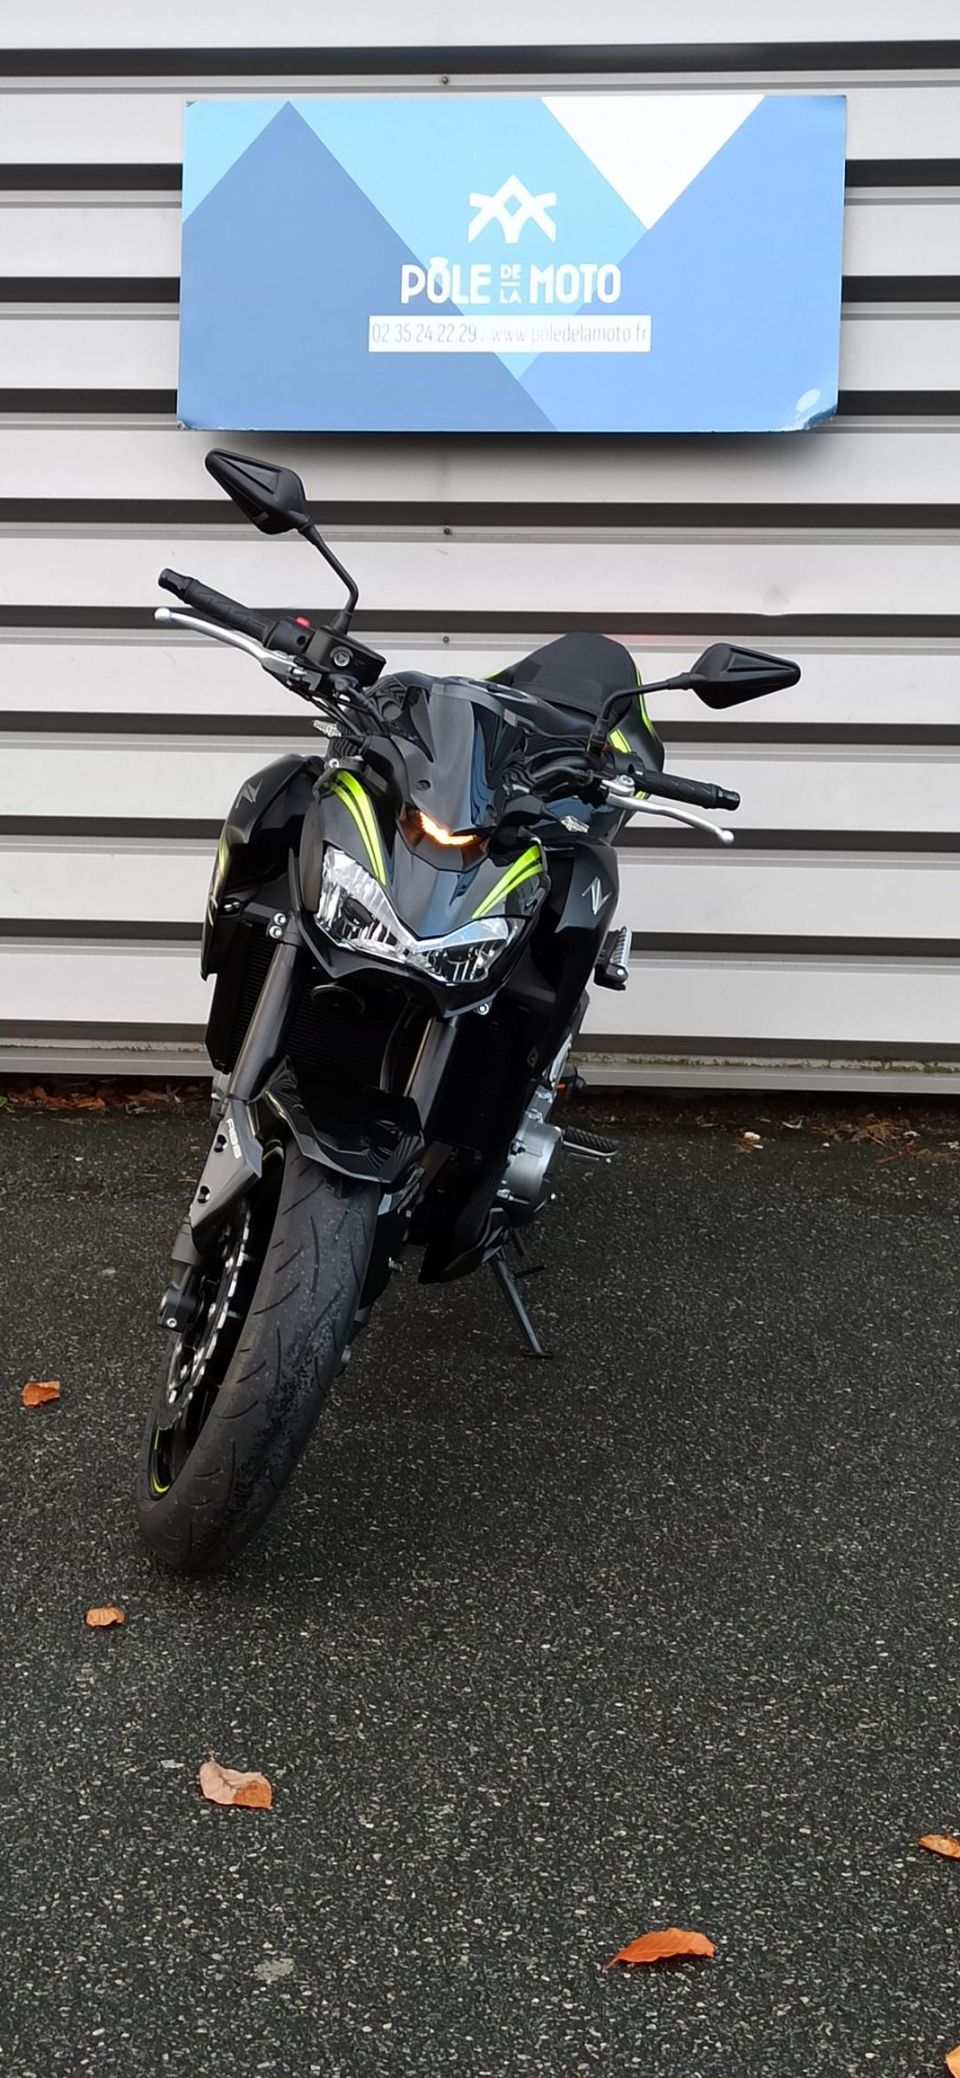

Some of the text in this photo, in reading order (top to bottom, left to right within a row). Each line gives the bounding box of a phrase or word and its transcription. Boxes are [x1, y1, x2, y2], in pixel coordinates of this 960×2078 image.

[400, 256, 622, 304] PÔLE DE LA MOTO
